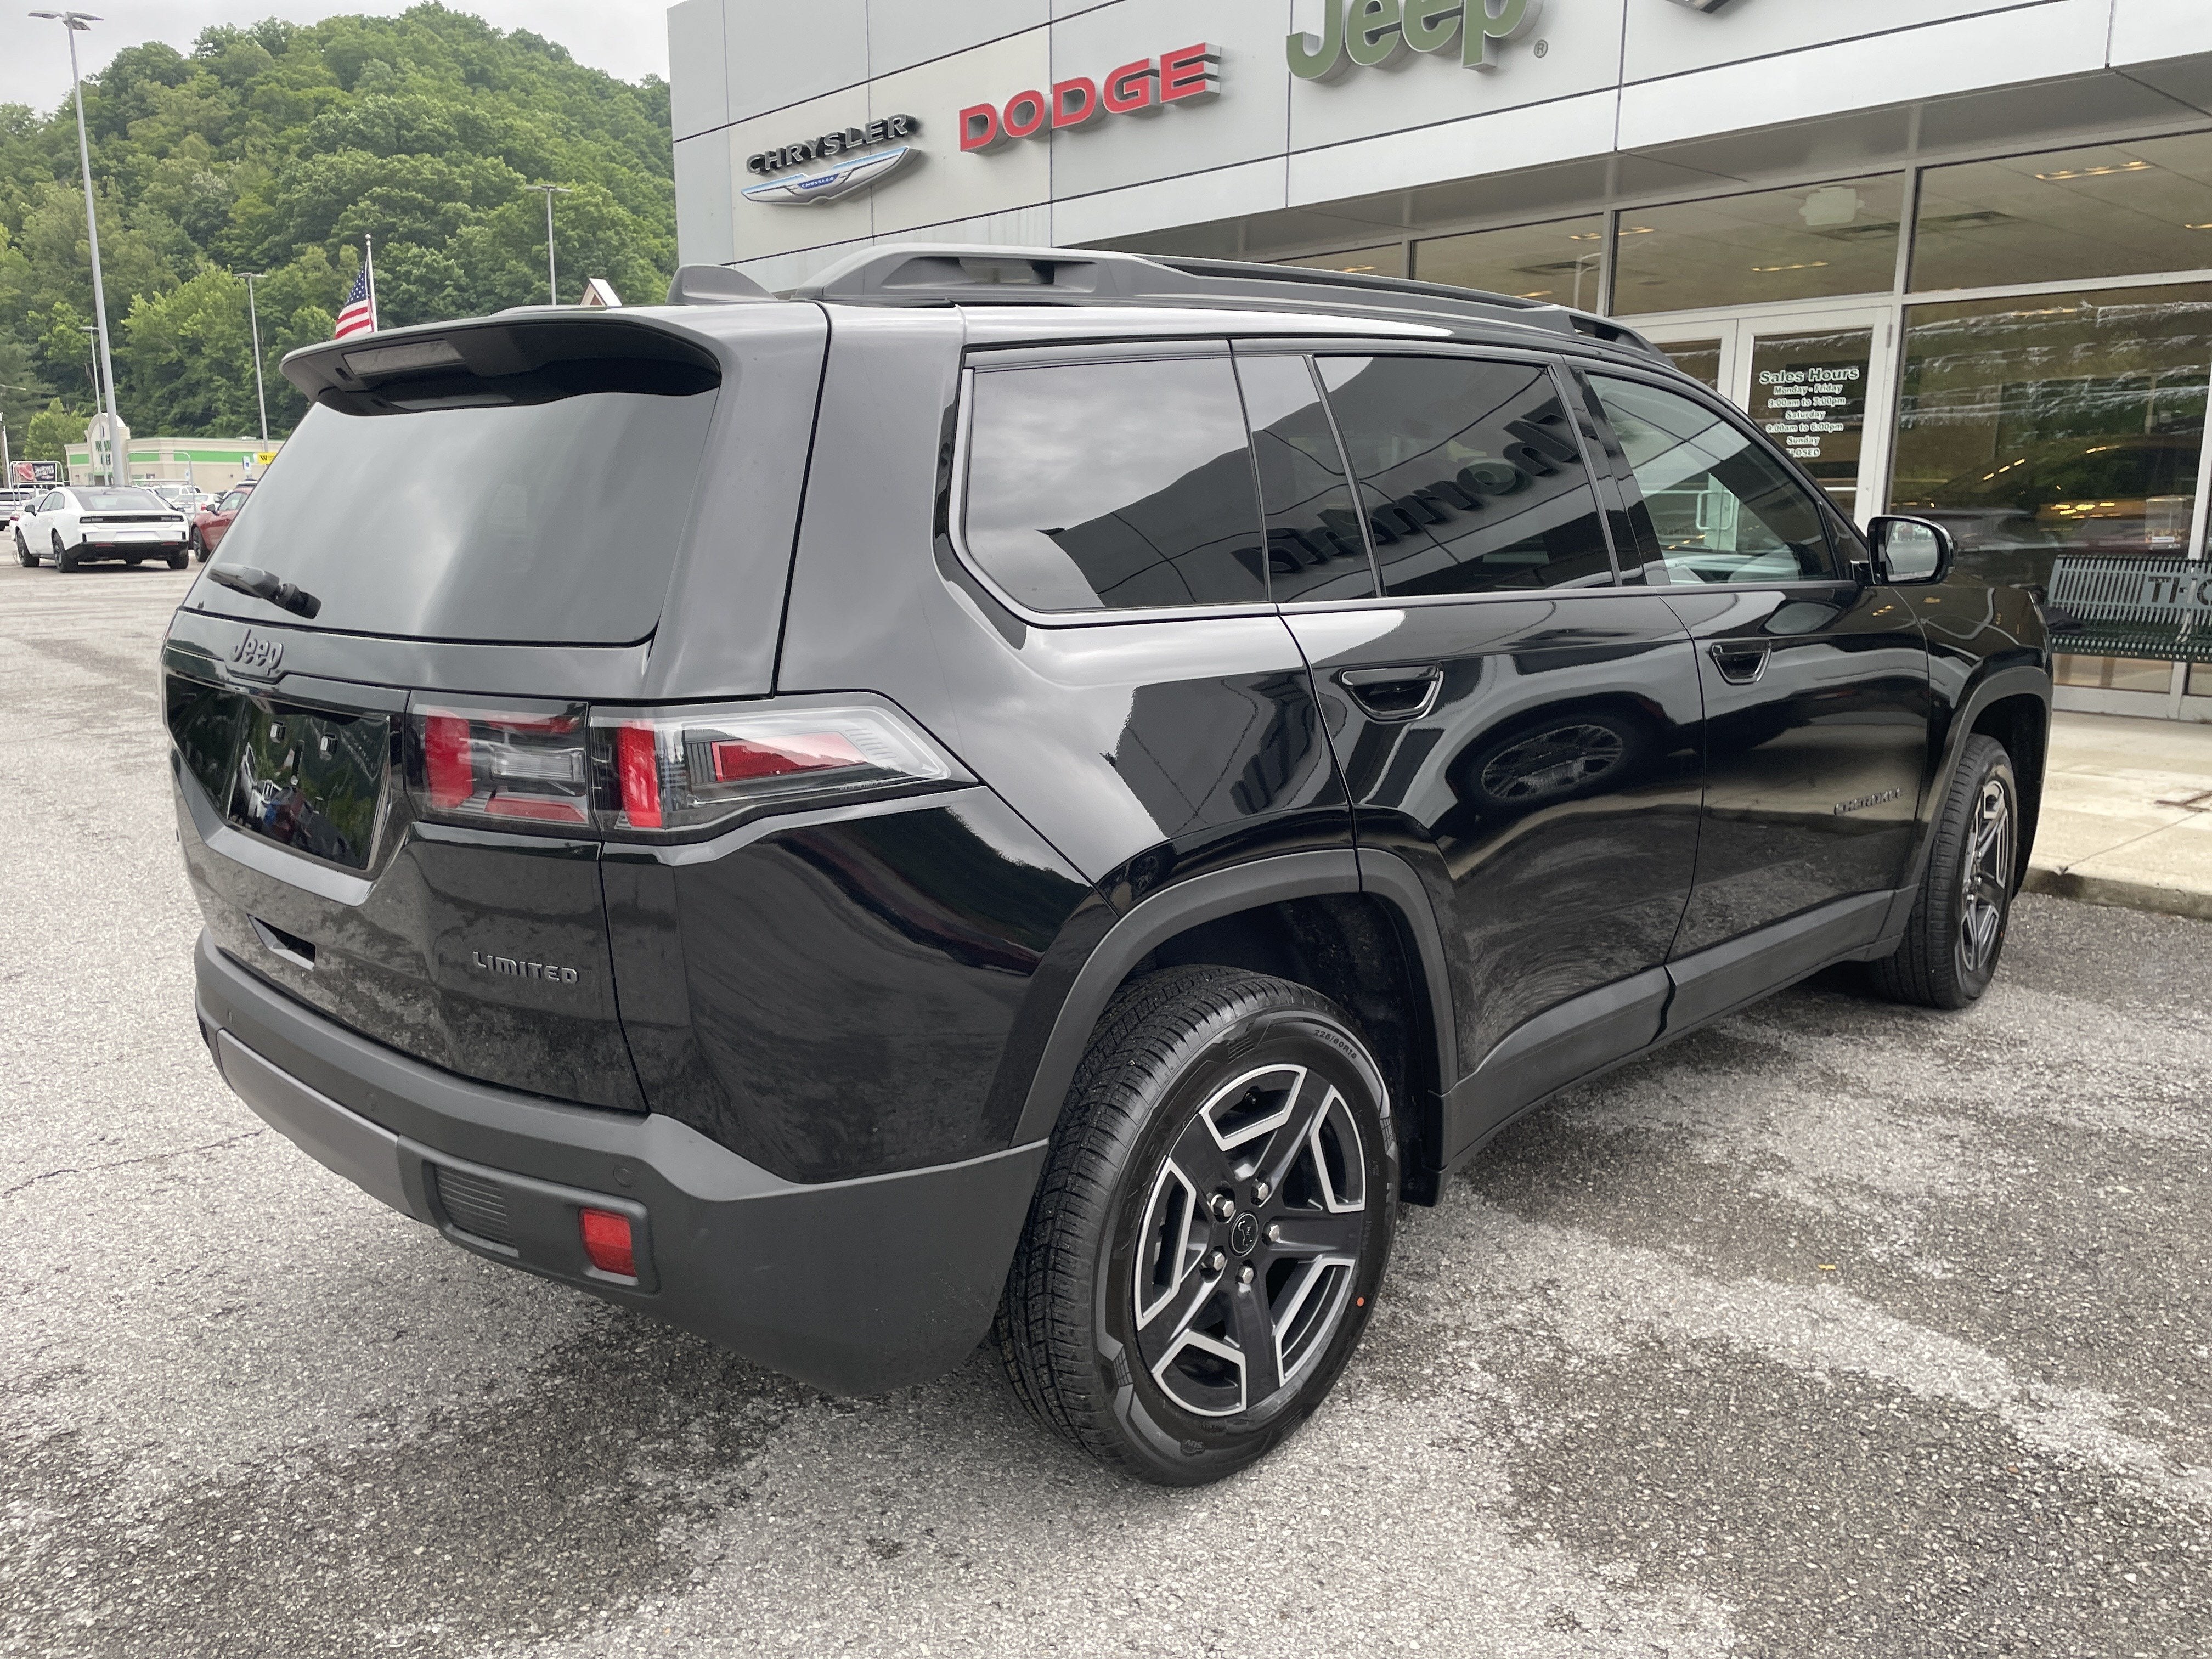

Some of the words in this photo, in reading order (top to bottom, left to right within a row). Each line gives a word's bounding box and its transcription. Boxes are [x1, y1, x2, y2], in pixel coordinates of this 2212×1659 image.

[1286, 0, 1530, 80] Jeep
[959, 42, 1210, 152] DODGE
[746, 114, 909, 174] CHRYSLER
[1759, 370, 1804, 384] Sales
[1808, 368, 1860, 382] Hours
[1773, 385, 1808, 396] Monday
[1814, 383, 1843, 394] Friday
[1801, 397, 1812, 407] to
[1785, 409, 1826, 421] Saturday
[1798, 422, 1809, 432] to
[1786, 435, 1820, 446] Sunday
[230, 629, 284, 676] Jeep
[472, 951, 579, 984] LIMITED
